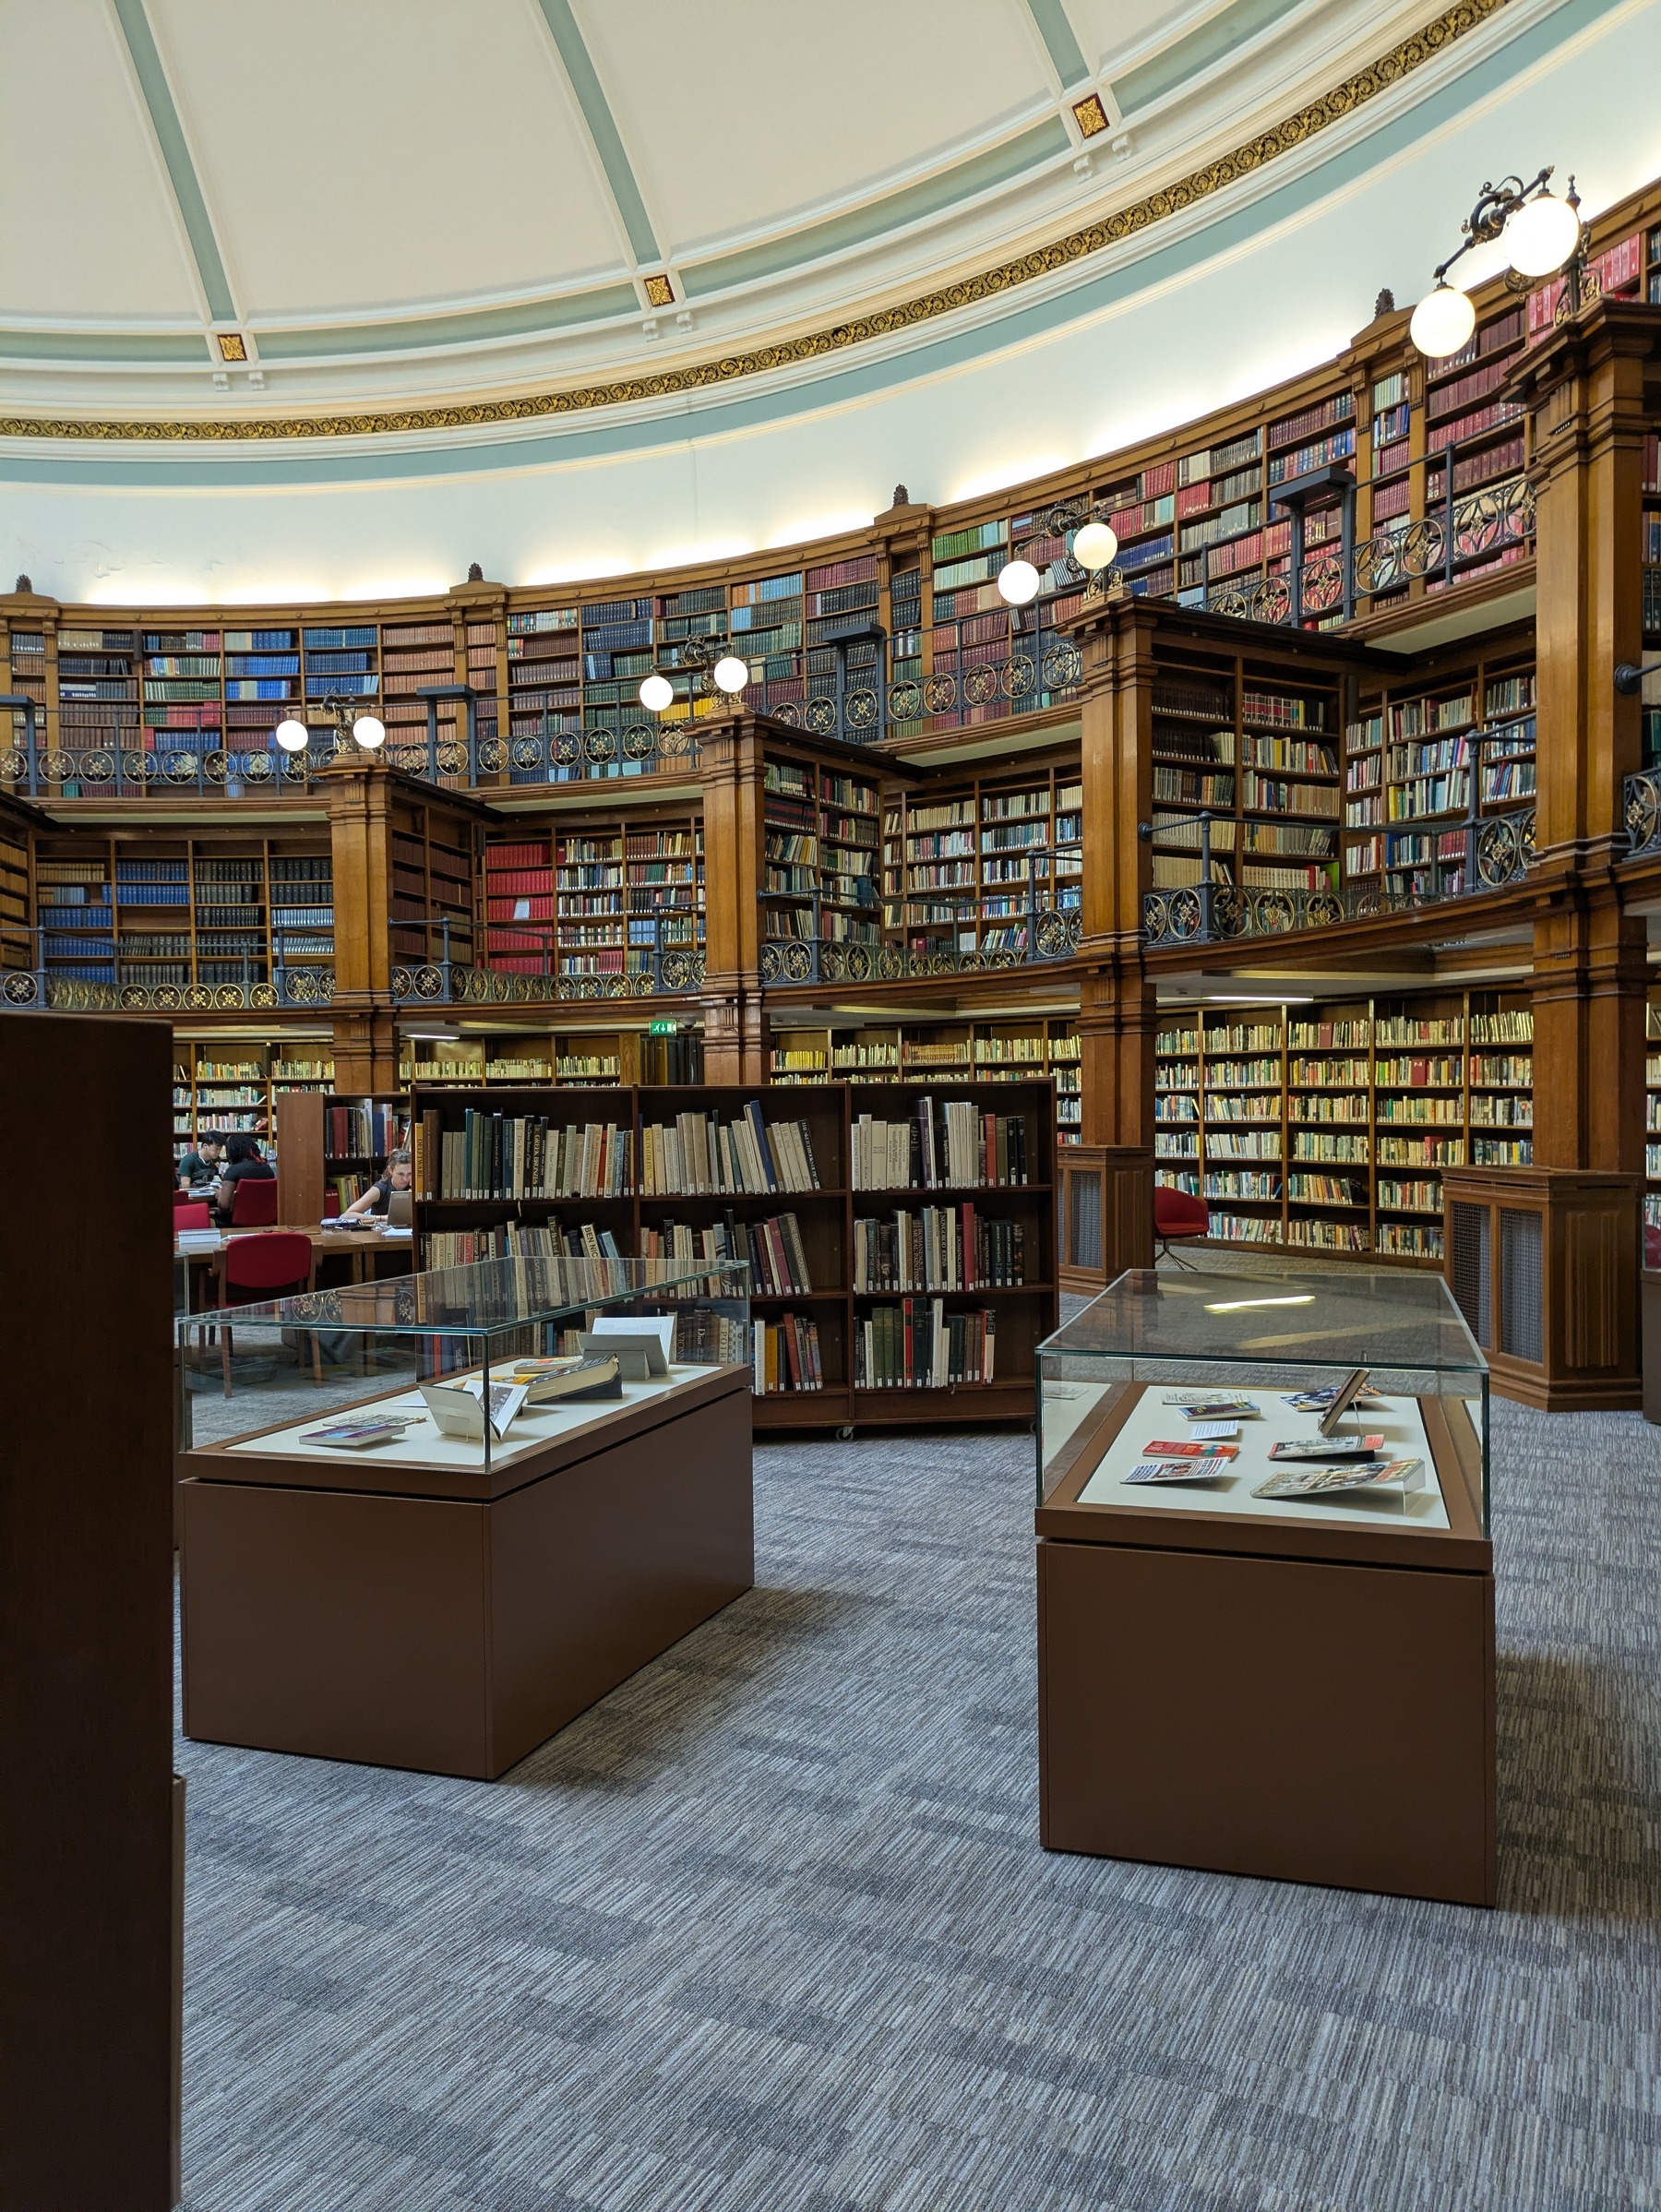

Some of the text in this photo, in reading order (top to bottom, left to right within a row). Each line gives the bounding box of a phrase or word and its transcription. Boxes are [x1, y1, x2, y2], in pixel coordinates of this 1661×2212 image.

[585, 1227, 594, 1243] BEN
[797, 1257, 808, 1286] TAPESTRY
[698, 1328, 706, 1345] Dior
